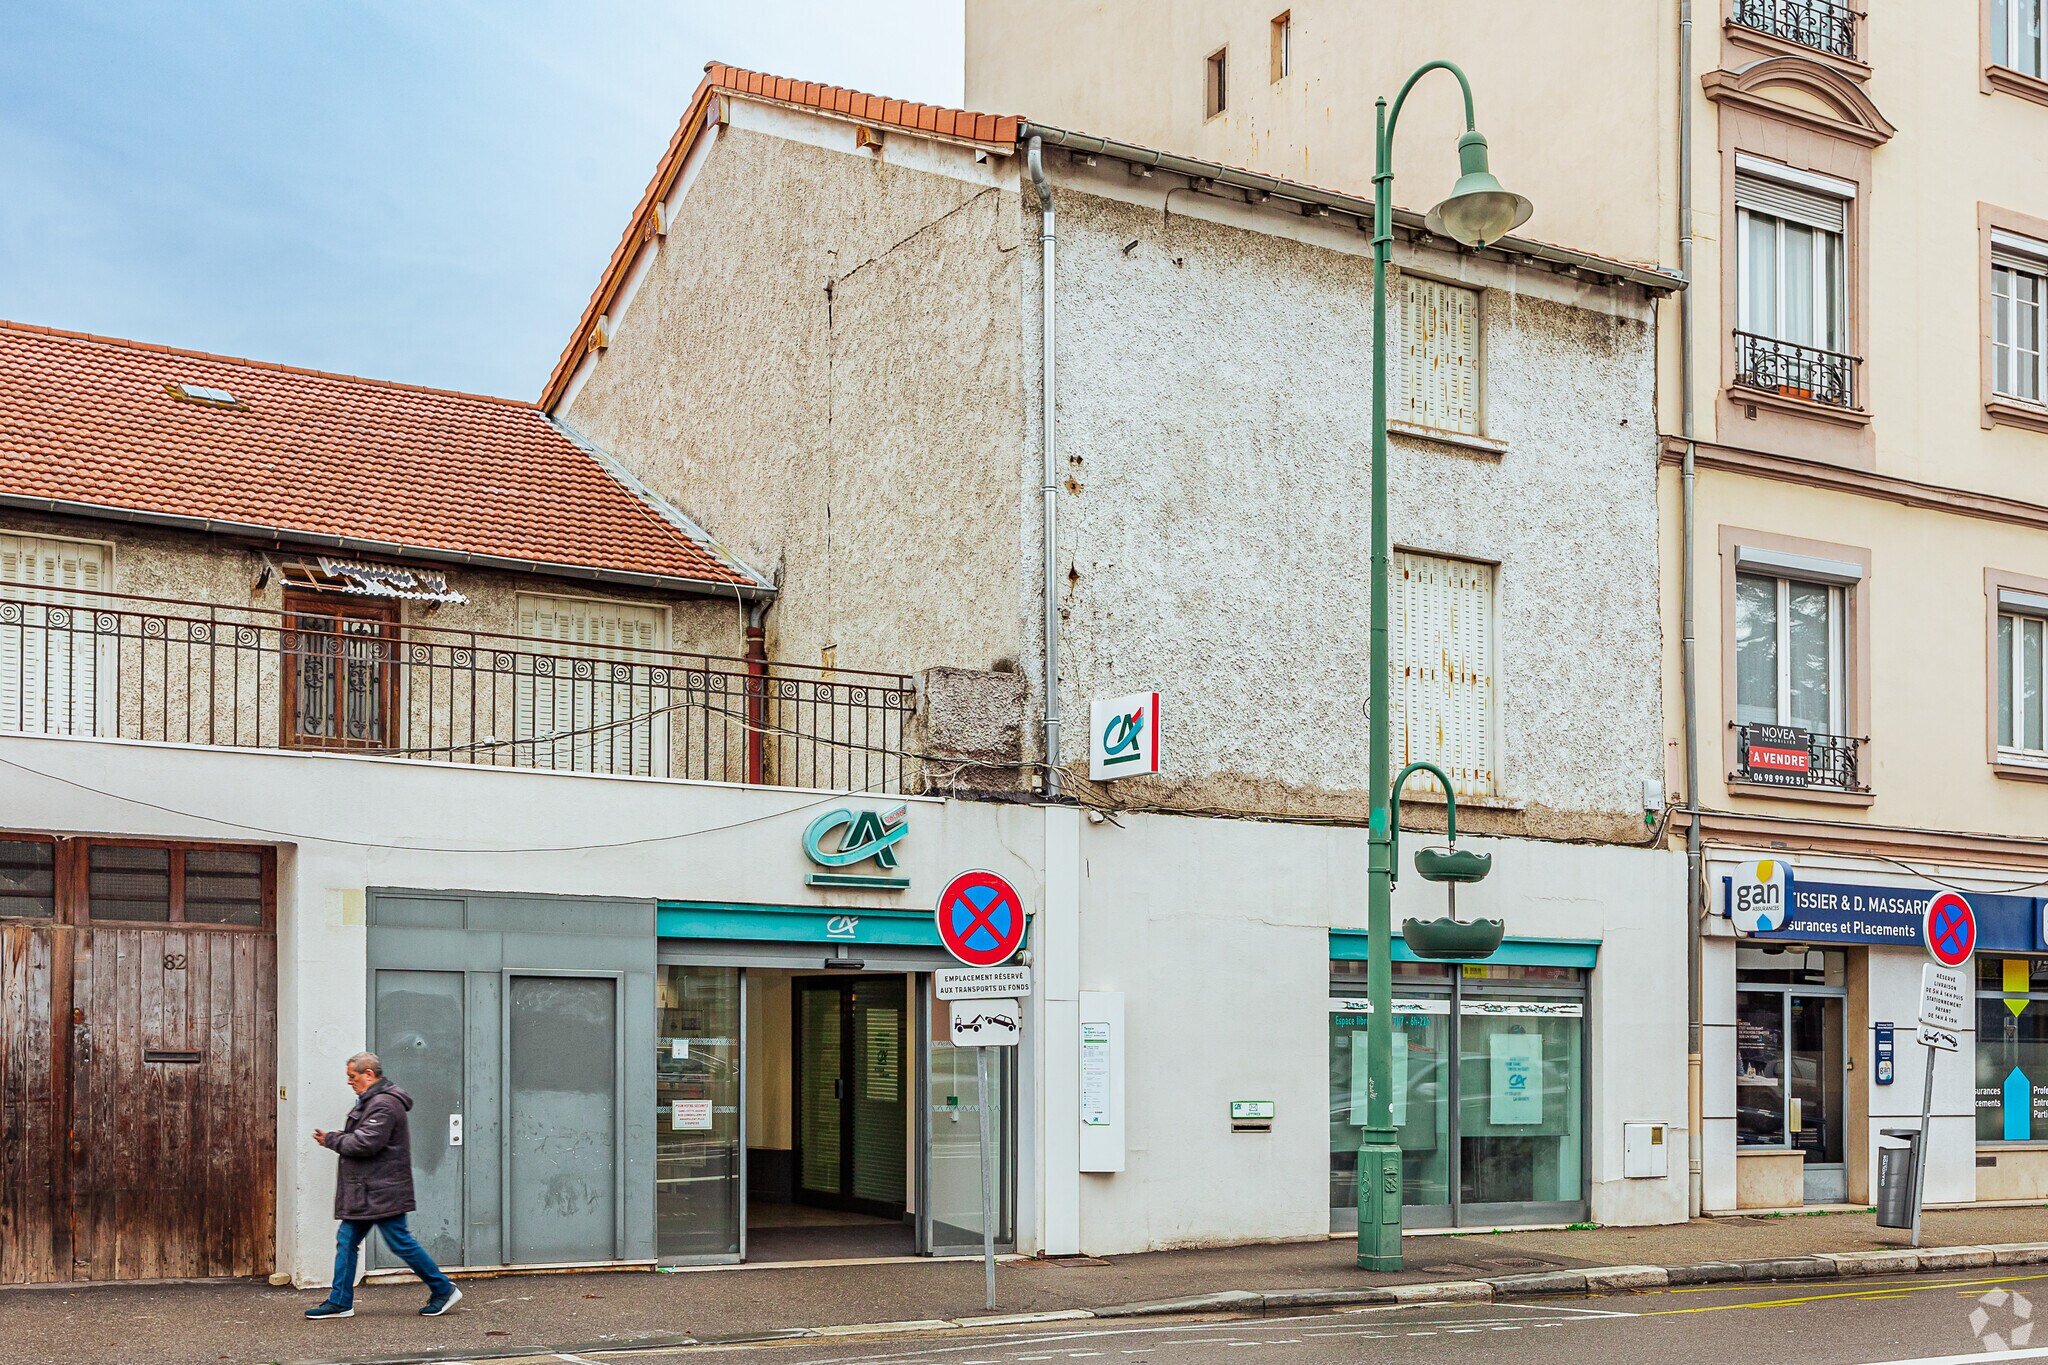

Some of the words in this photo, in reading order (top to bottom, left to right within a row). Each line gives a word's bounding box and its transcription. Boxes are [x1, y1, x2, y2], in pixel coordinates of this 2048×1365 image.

[1103, 706, 1144, 755] CA
[1761, 727, 1796, 740] NOVEA
[1753, 751, 1760, 763] A
[1763, 752, 1805, 767] VENDRE
[1753, 773, 1763, 781] 06
[1764, 773, 1773, 782] 98
[1775, 774, 1784, 783] 99
[1785, 775, 1794, 784] 92
[1796, 776, 1804, 785] 51
[802, 807, 909, 868] CA
[1736, 883, 1780, 912] gan
[1841, 895, 1851, 911] &
[1853, 895, 1866, 912] D.
[1840, 921, 1851, 934] et
[1853, 921, 1916, 937] Placements
[164, 954, 187, 970] 82
[944, 974, 993, 982] EMPLACEMENT
[994, 972, 1024, 980] RÉSERVÉ
[940, 986, 953, 994] AUX
[955, 985, 997, 993] TRANSPORTS
[998, 984, 1006, 992] DE
[1008, 983, 1030, 991] FONDS
[1934, 981, 1957, 991] LIVRAISON
[1926, 995, 1962, 1008] STATIONNEMENT
[1935, 1006, 1952, 1014] PAYANT
[1335, 1015, 1355, 1028] Espace
